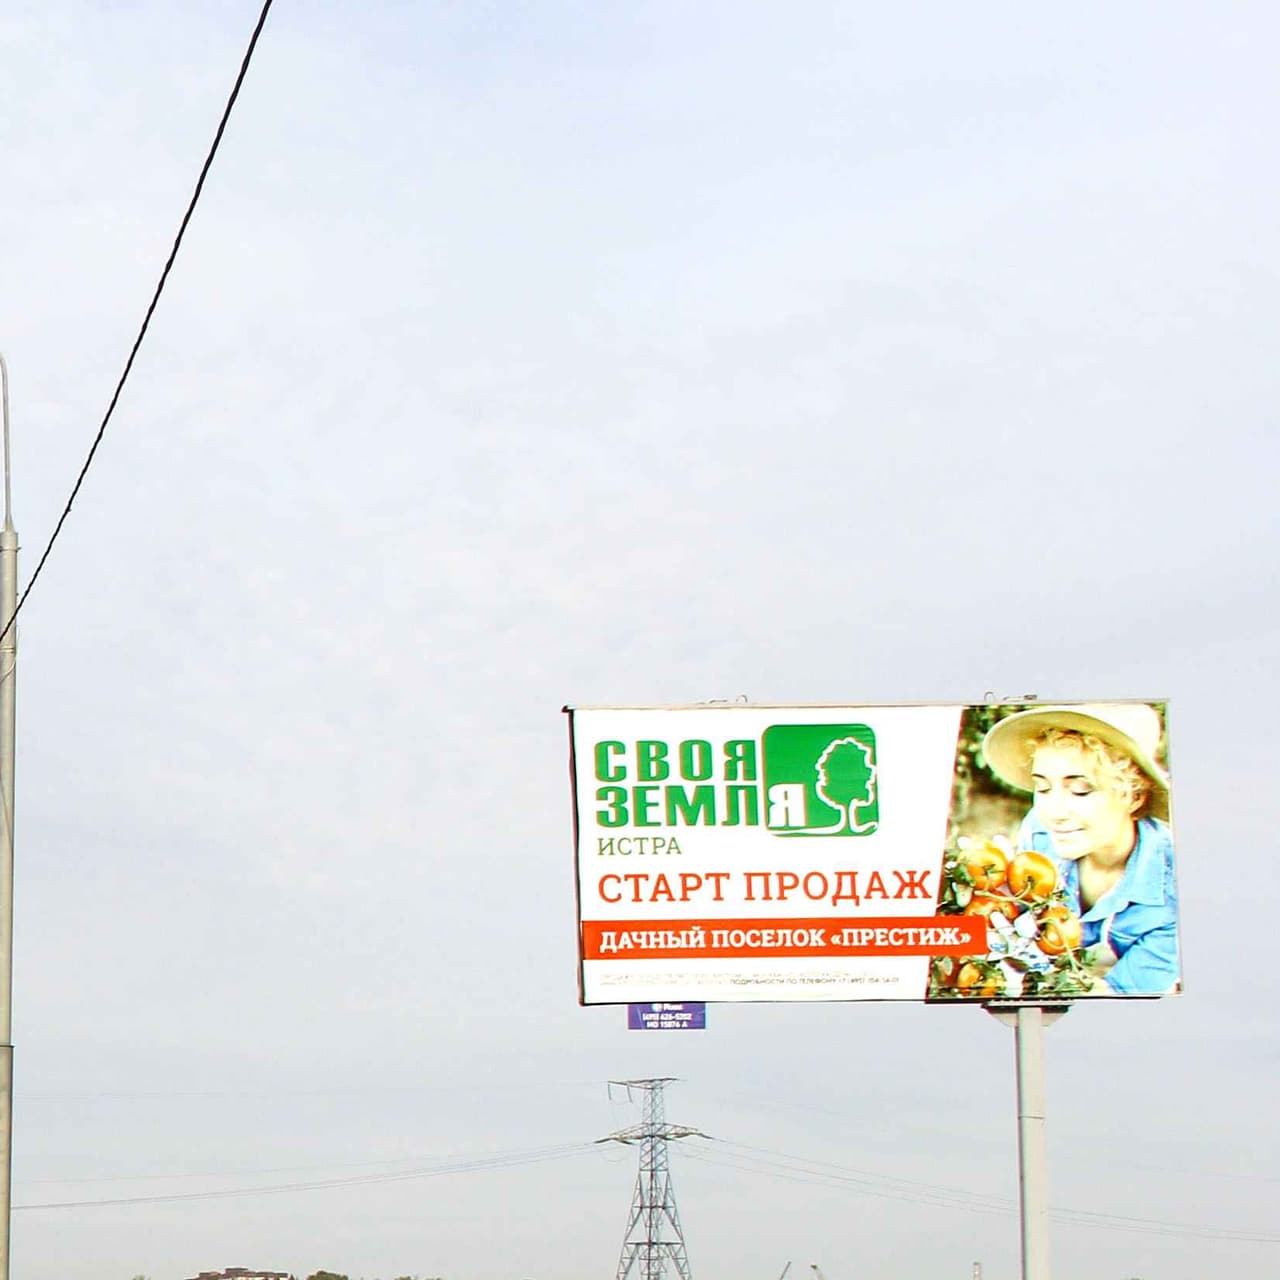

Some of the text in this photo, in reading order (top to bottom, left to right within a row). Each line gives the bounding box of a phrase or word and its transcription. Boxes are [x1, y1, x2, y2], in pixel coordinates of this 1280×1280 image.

[594, 739, 757, 782] СВОЯ
[596, 783, 807, 827] ЗЕМЛЯ
[597, 837, 682, 855] ИСТРА
[598, 870, 933, 906] СТАРТ ПРОДАЖ
[600, 926, 972, 953] ДАЧНЫЙ ПОСЕЛОК «ПРЕСТИЖ»
